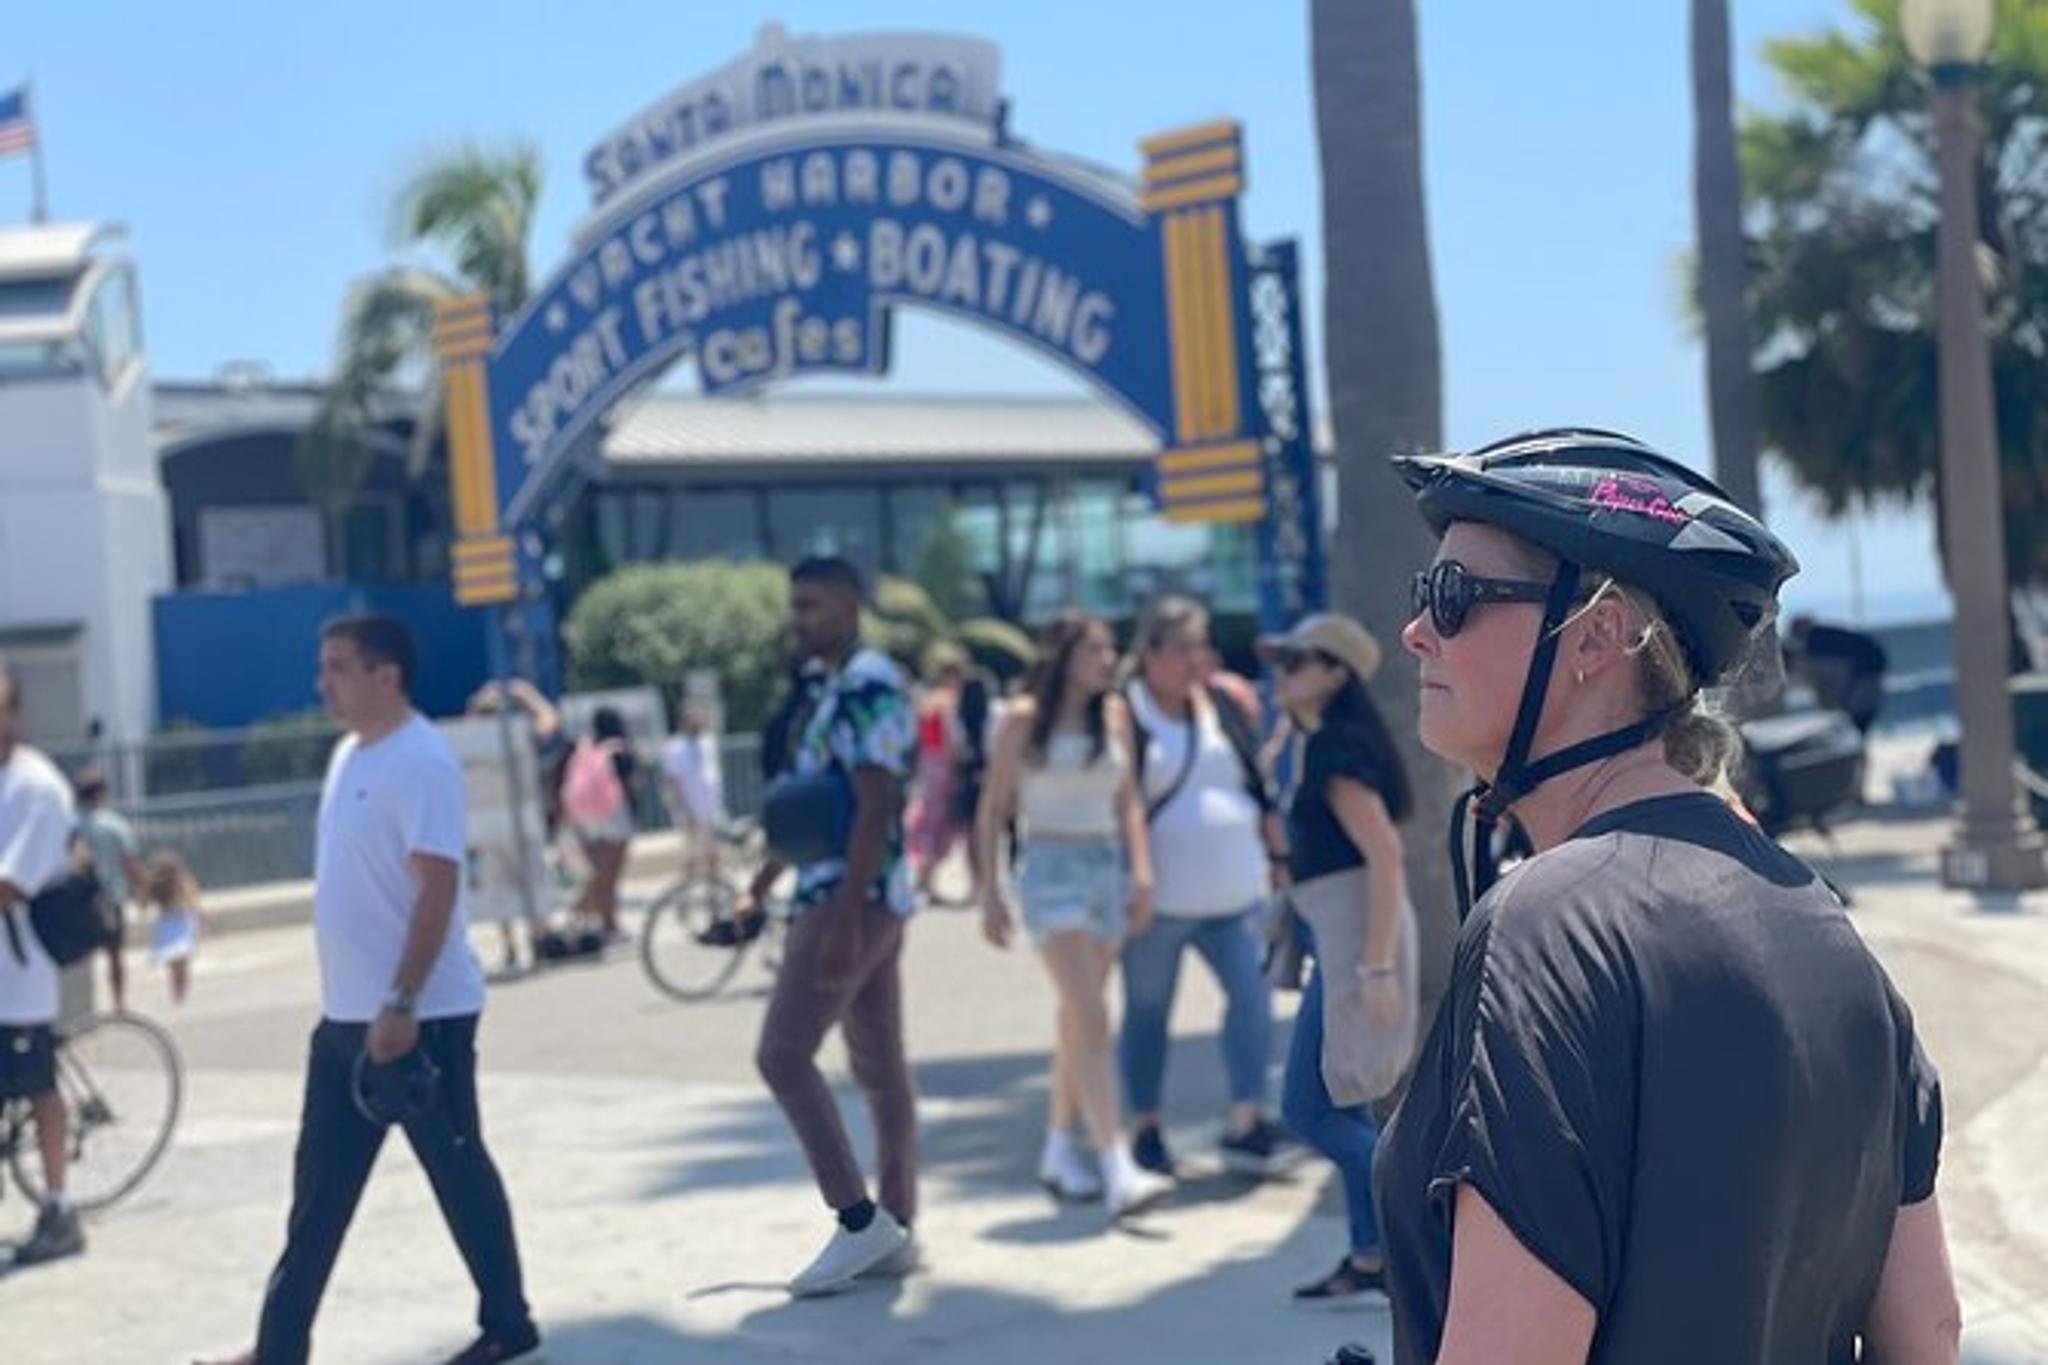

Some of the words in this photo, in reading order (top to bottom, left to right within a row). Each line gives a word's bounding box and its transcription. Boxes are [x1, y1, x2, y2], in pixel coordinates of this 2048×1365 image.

[583, 90, 734, 204] SANTA
[755, 60, 962, 122] MONICA
[568, 176, 728, 308] YACHT
[760, 149, 1011, 222] HARBOR
[510, 304, 628, 466] SPORT
[634, 220, 822, 345] FISHING
[868, 216, 1116, 364] BOATING
